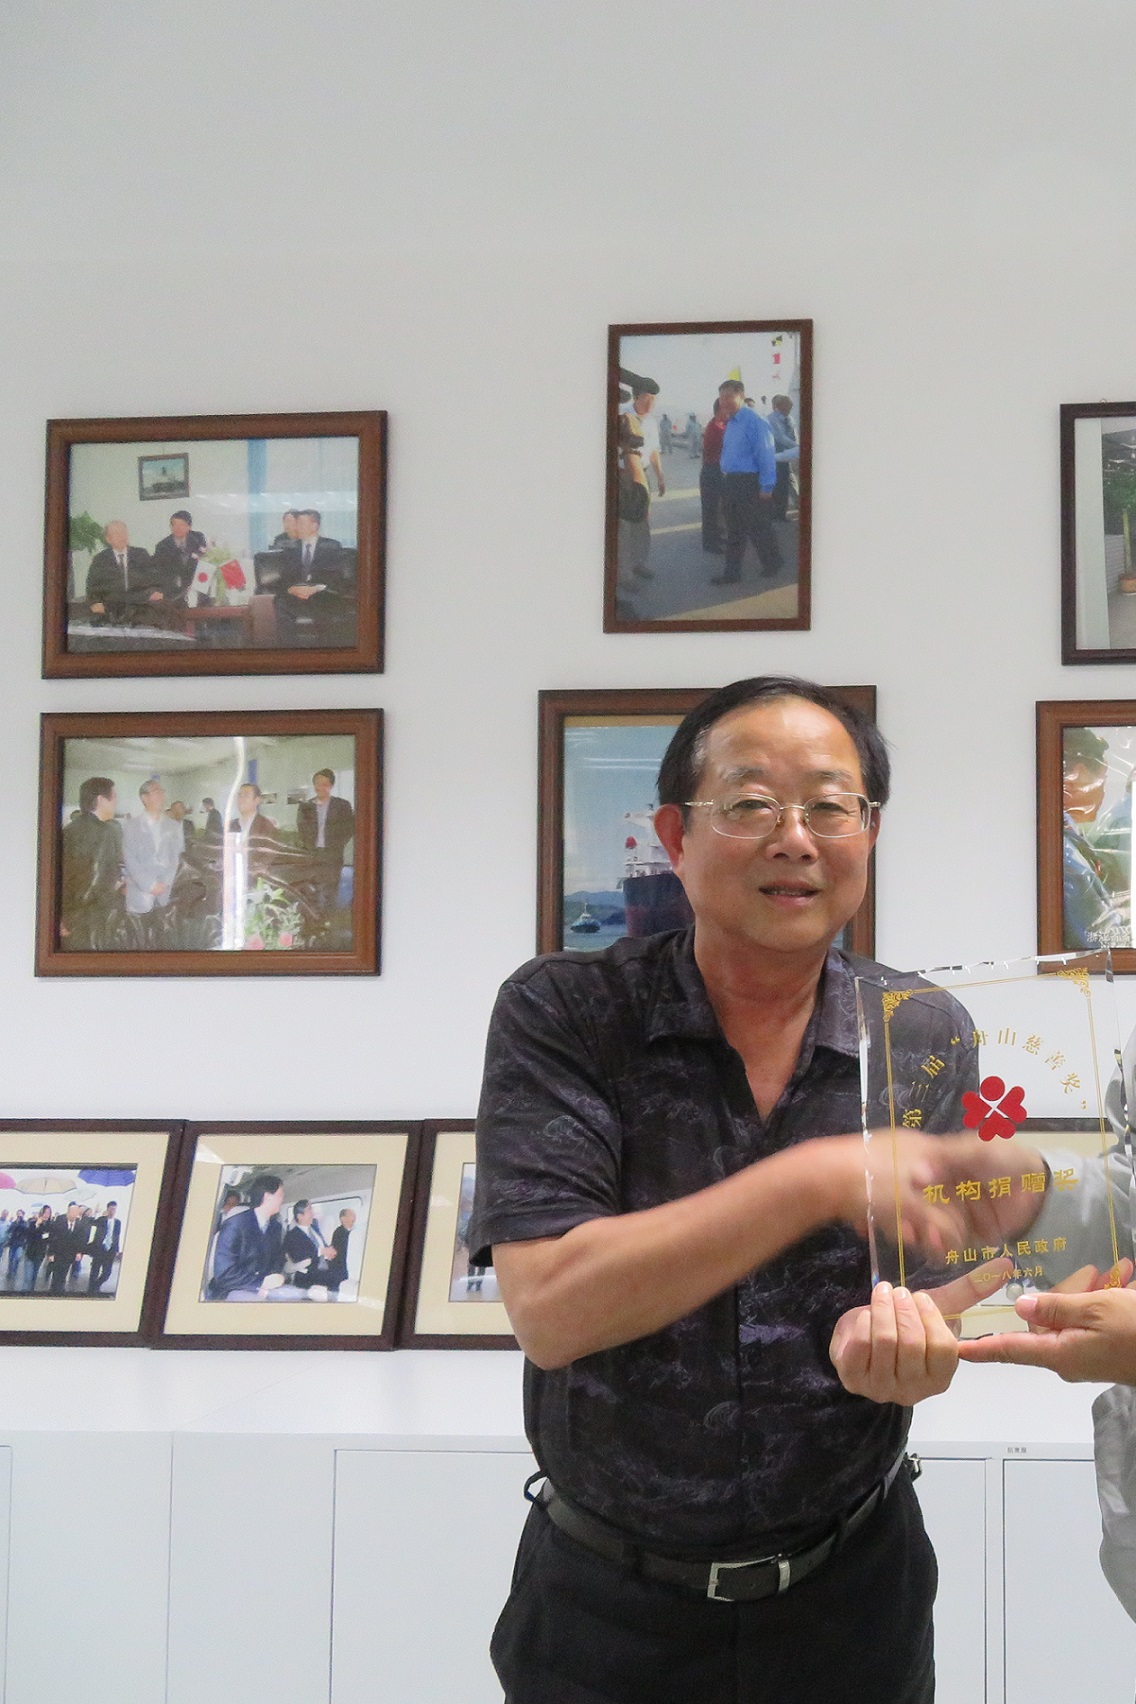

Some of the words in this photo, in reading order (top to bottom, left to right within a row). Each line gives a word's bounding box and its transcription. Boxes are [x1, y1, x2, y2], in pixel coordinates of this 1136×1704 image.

[923, 1168, 1080, 1205] 机构捐赠奖
[945, 1237, 1067, 1265] 舟山市人民政府
